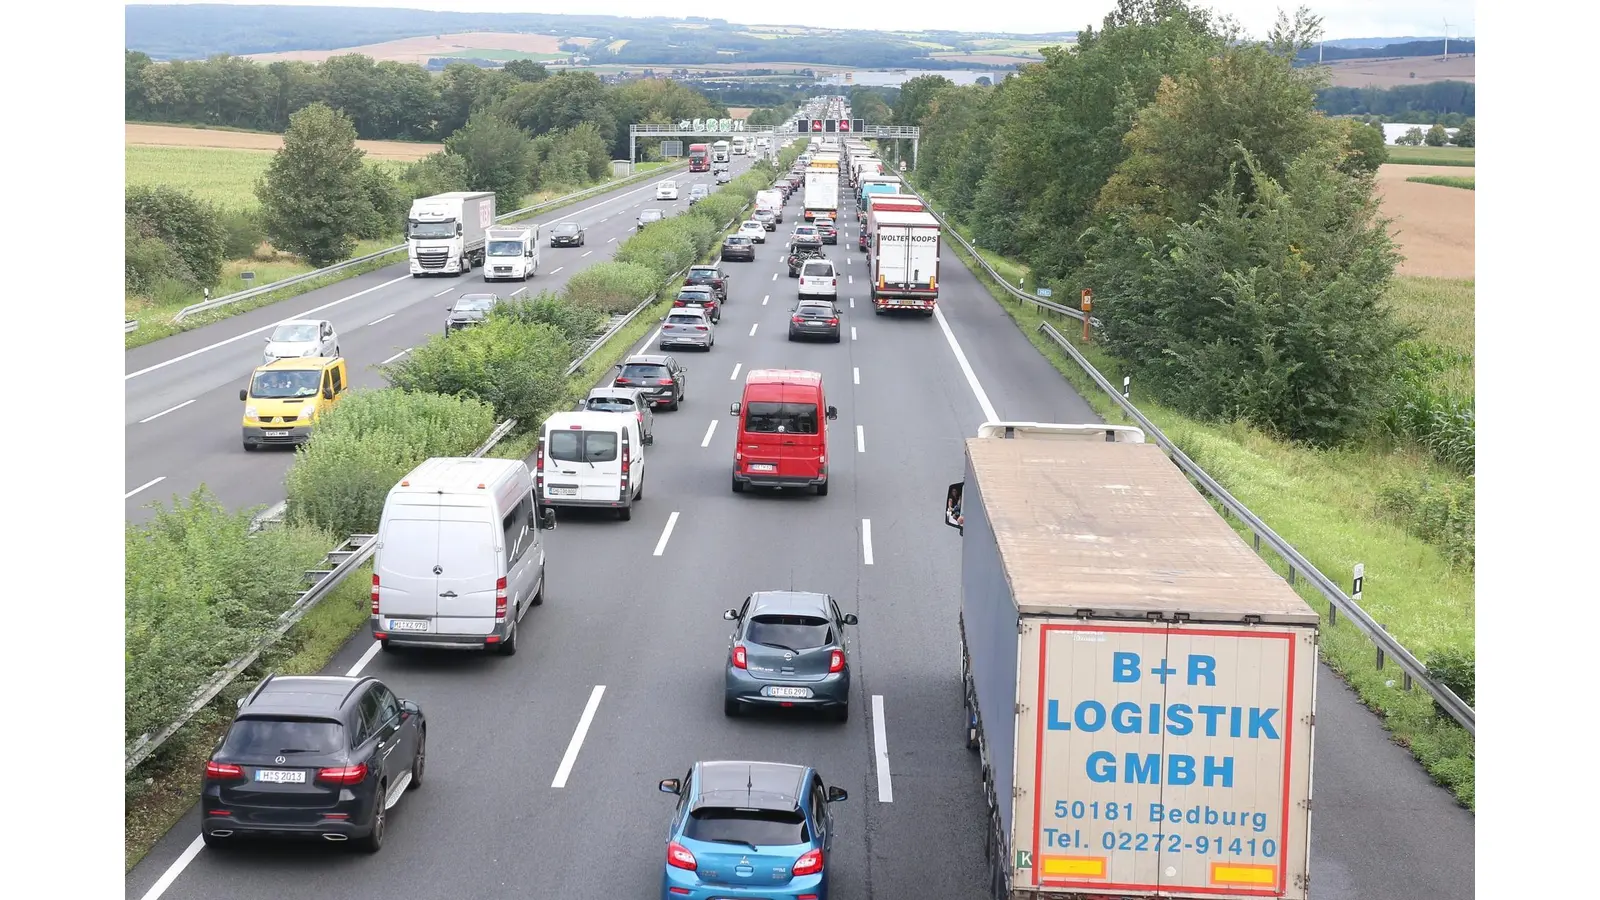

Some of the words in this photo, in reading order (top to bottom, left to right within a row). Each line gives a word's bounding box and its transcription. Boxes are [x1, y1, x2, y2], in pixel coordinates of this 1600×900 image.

[1047, 699, 1281, 740] LOGISTIK
[1085, 750, 1235, 788] GMBH
[1054, 800, 1134, 821] 50181
[1149, 803, 1267, 832] Bedburg
[1021, 851, 1033, 866] K
[1043, 828, 1089, 849] Tel.
[1102, 831, 1277, 858] 02272-91410
